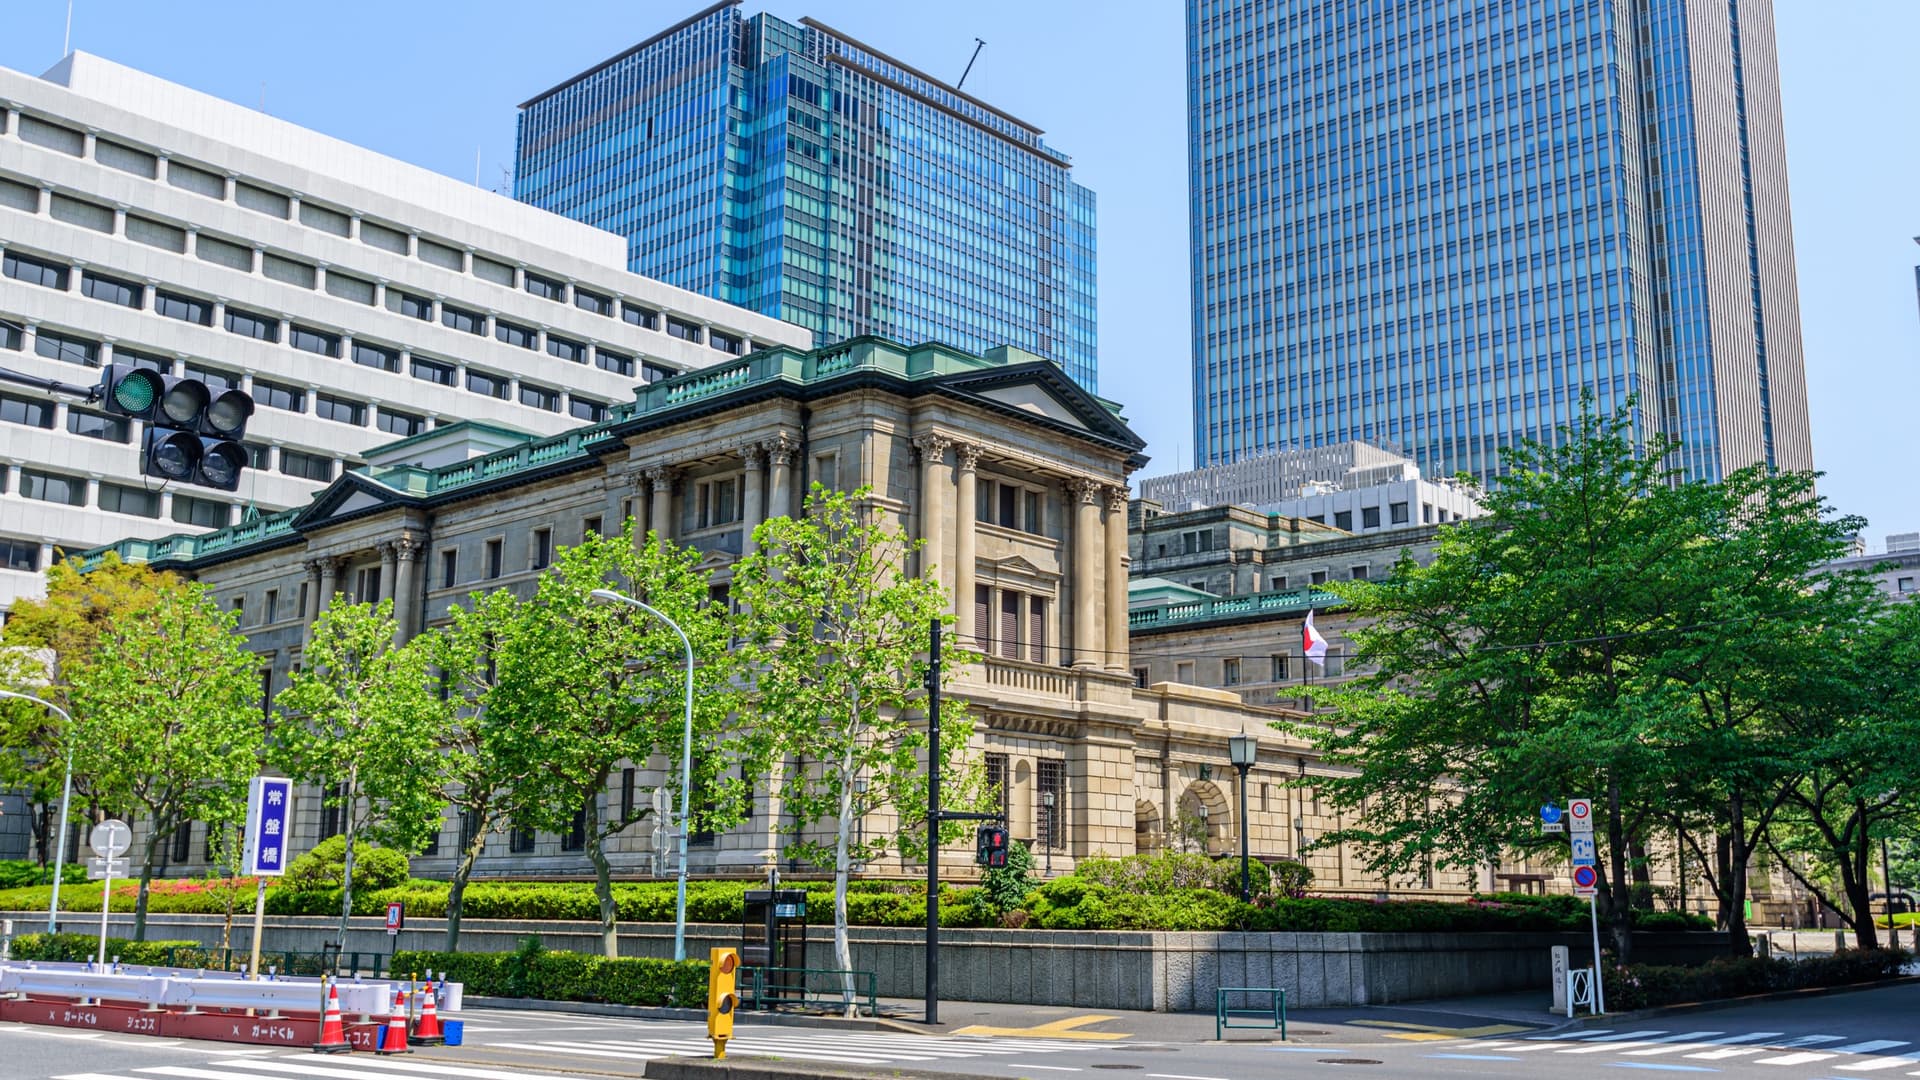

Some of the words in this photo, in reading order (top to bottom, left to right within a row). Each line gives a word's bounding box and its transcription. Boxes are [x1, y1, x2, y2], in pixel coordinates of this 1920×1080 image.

[262, 789, 283, 864] 常盤橋
[64, 1011, 97, 1024] ガードくん
[251, 1025, 294, 1040] ガードくん
